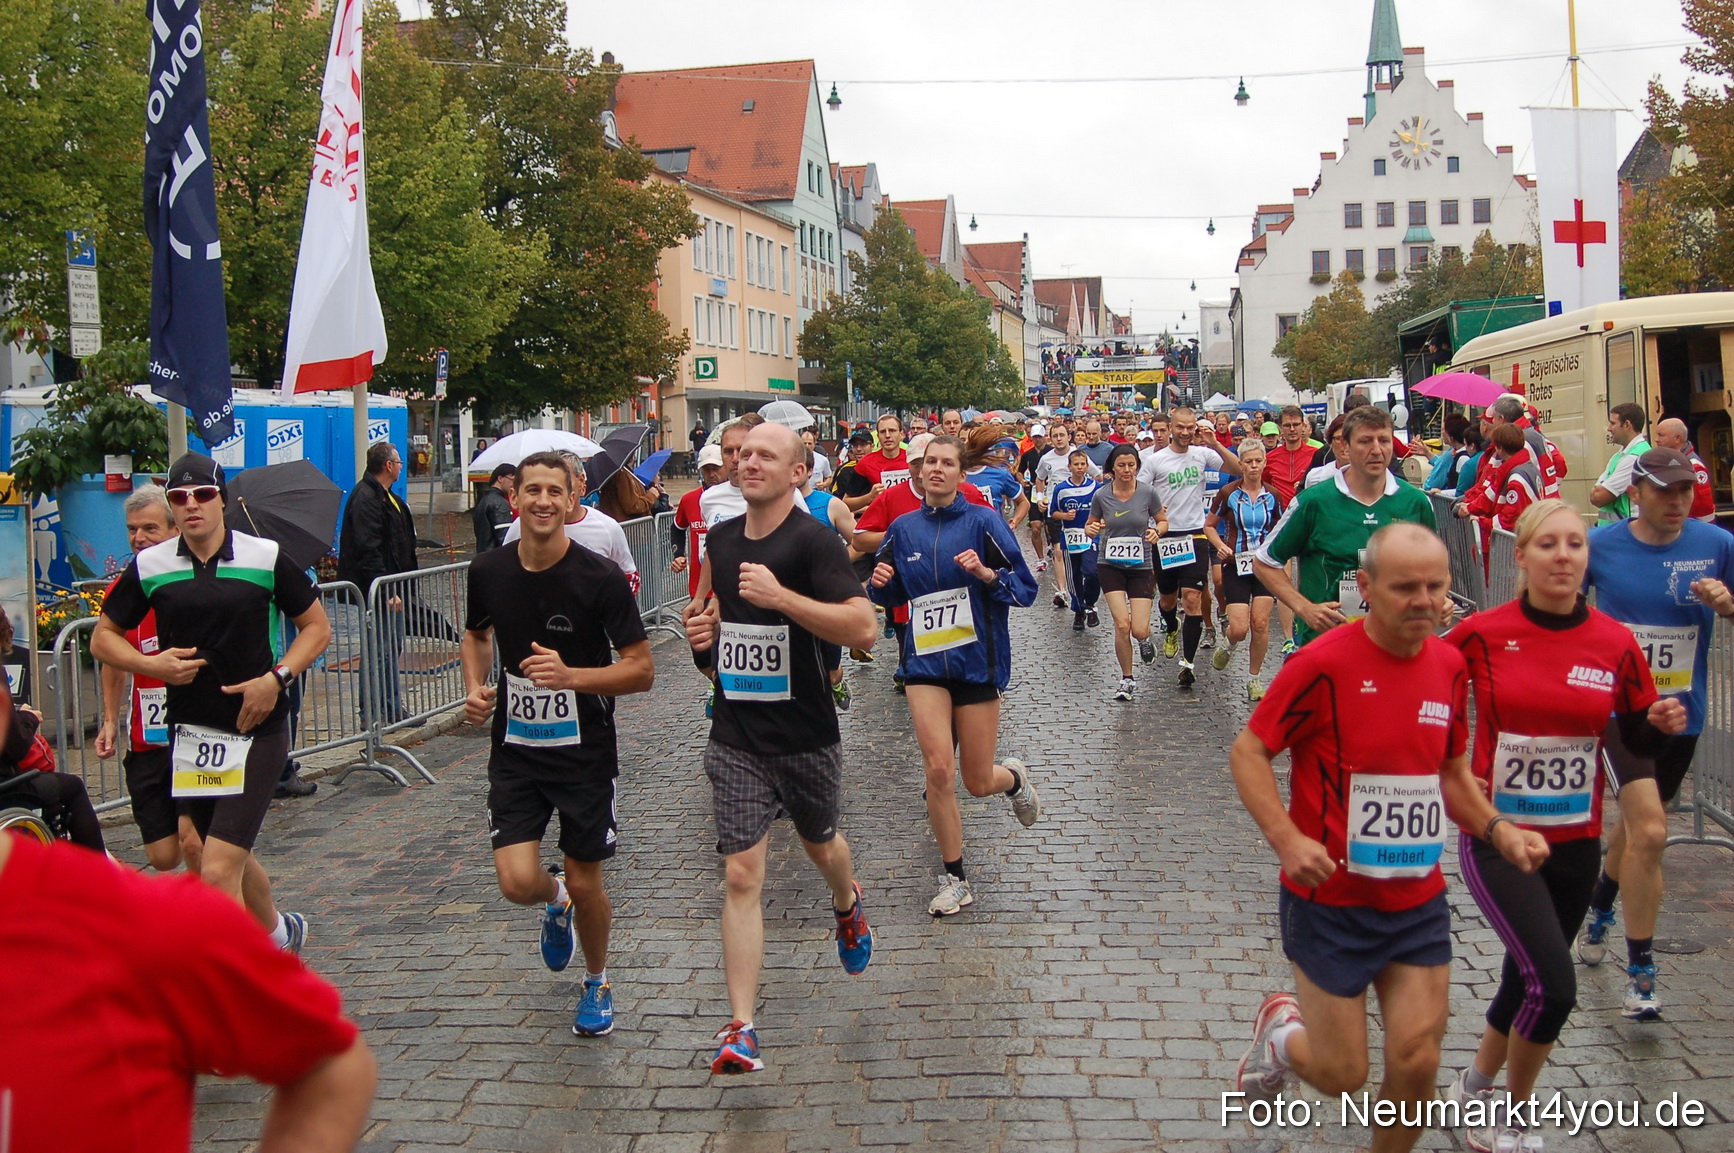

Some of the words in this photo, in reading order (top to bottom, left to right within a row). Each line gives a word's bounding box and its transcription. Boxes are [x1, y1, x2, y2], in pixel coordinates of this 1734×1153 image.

[1530, 352, 1579, 380] Bayerisches
[1104, 374, 1134, 382] START
[1530, 382, 1552, 402] Rotes
[1538, 410, 1552, 424] euz
[1110, 546, 1140, 558] 2212
[1162, 542, 1190, 556] 2641
[1674, 559, 1714, 567] NEUMARKTER
[1342, 570, 1358, 580] HE
[930, 596, 958, 606] Neumarkt
[924, 604, 958, 630] 577
[548, 624, 572, 632] MAN
[738, 632, 774, 641] Neumarkt
[1646, 632, 1685, 640] Neumarkt
[722, 642, 782, 672] 3039
[1568, 666, 1614, 685] JURA
[1652, 676, 1670, 686] fan
[734, 677, 762, 690] Silvio
[511, 692, 570, 720] 2878
[1418, 700, 1449, 720] JURA
[201, 733, 238, 742] Neumarkt
[524, 726, 555, 737] Tobias
[196, 742, 226, 768] 80
[1500, 742, 1532, 754] PARTL
[1535, 744, 1579, 755] Neumarkt
[196, 774, 222, 785] Thom
[1505, 757, 1587, 790] 2633
[1352, 784, 1390, 796] PARTL
[1393, 786, 1436, 796] Neumarkt
[1517, 799, 1570, 813] Ramona
[1360, 800, 1441, 839] 2560
[1378, 849, 1425, 864] Herbert
